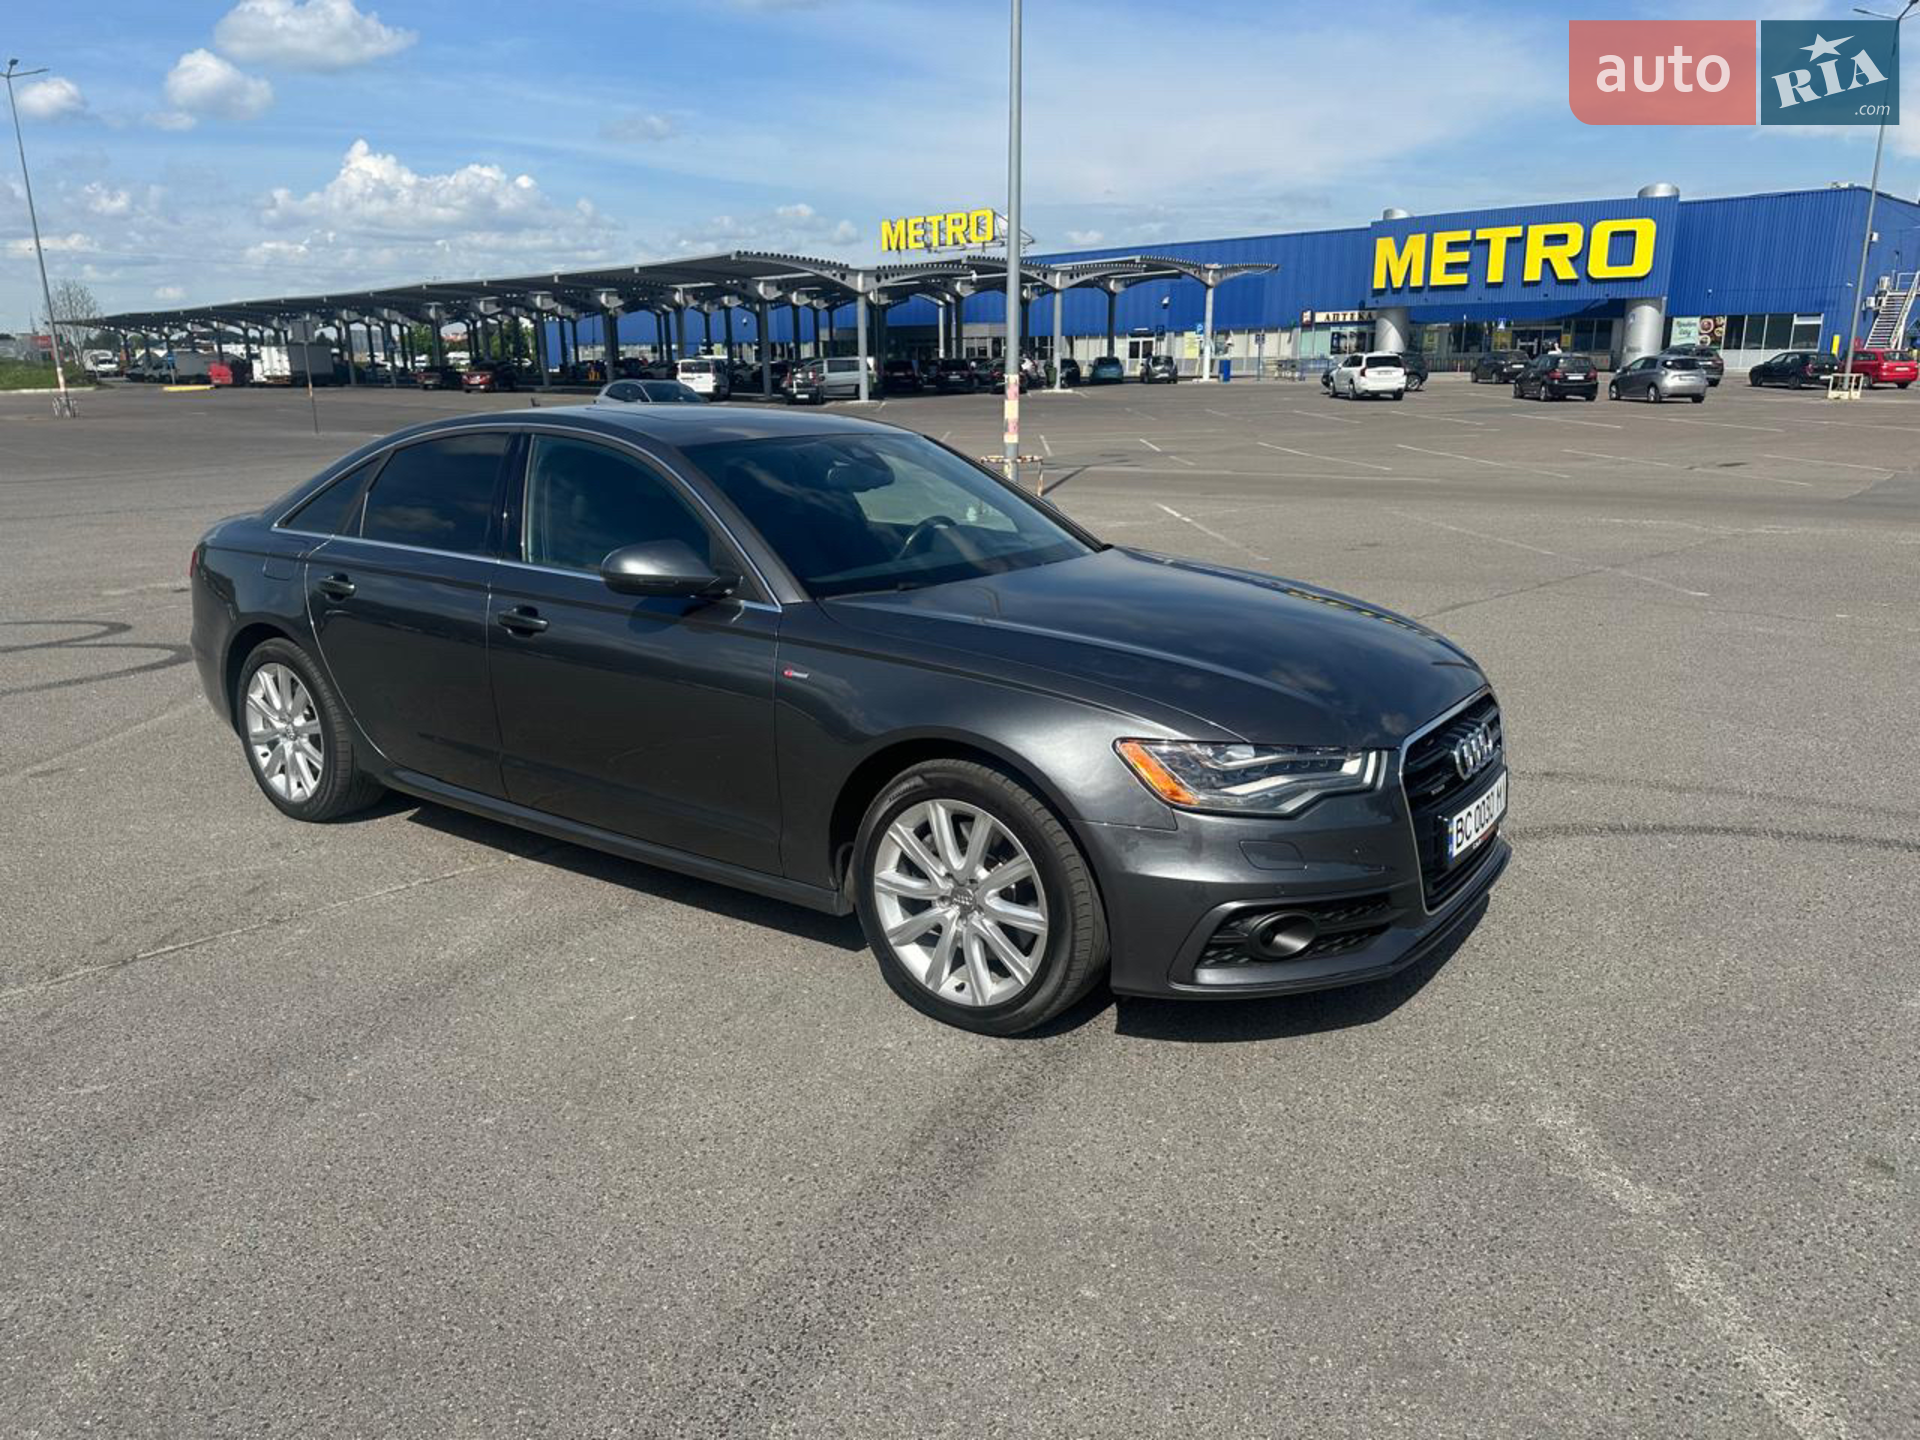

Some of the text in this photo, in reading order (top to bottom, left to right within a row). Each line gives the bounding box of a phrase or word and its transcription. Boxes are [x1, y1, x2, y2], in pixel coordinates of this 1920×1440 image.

[881, 209, 993, 252] METRO
[1373, 218, 1656, 289] METRO
[1325, 312, 1373, 321] АПТЕКА
[1456, 811, 1472, 849] BC
